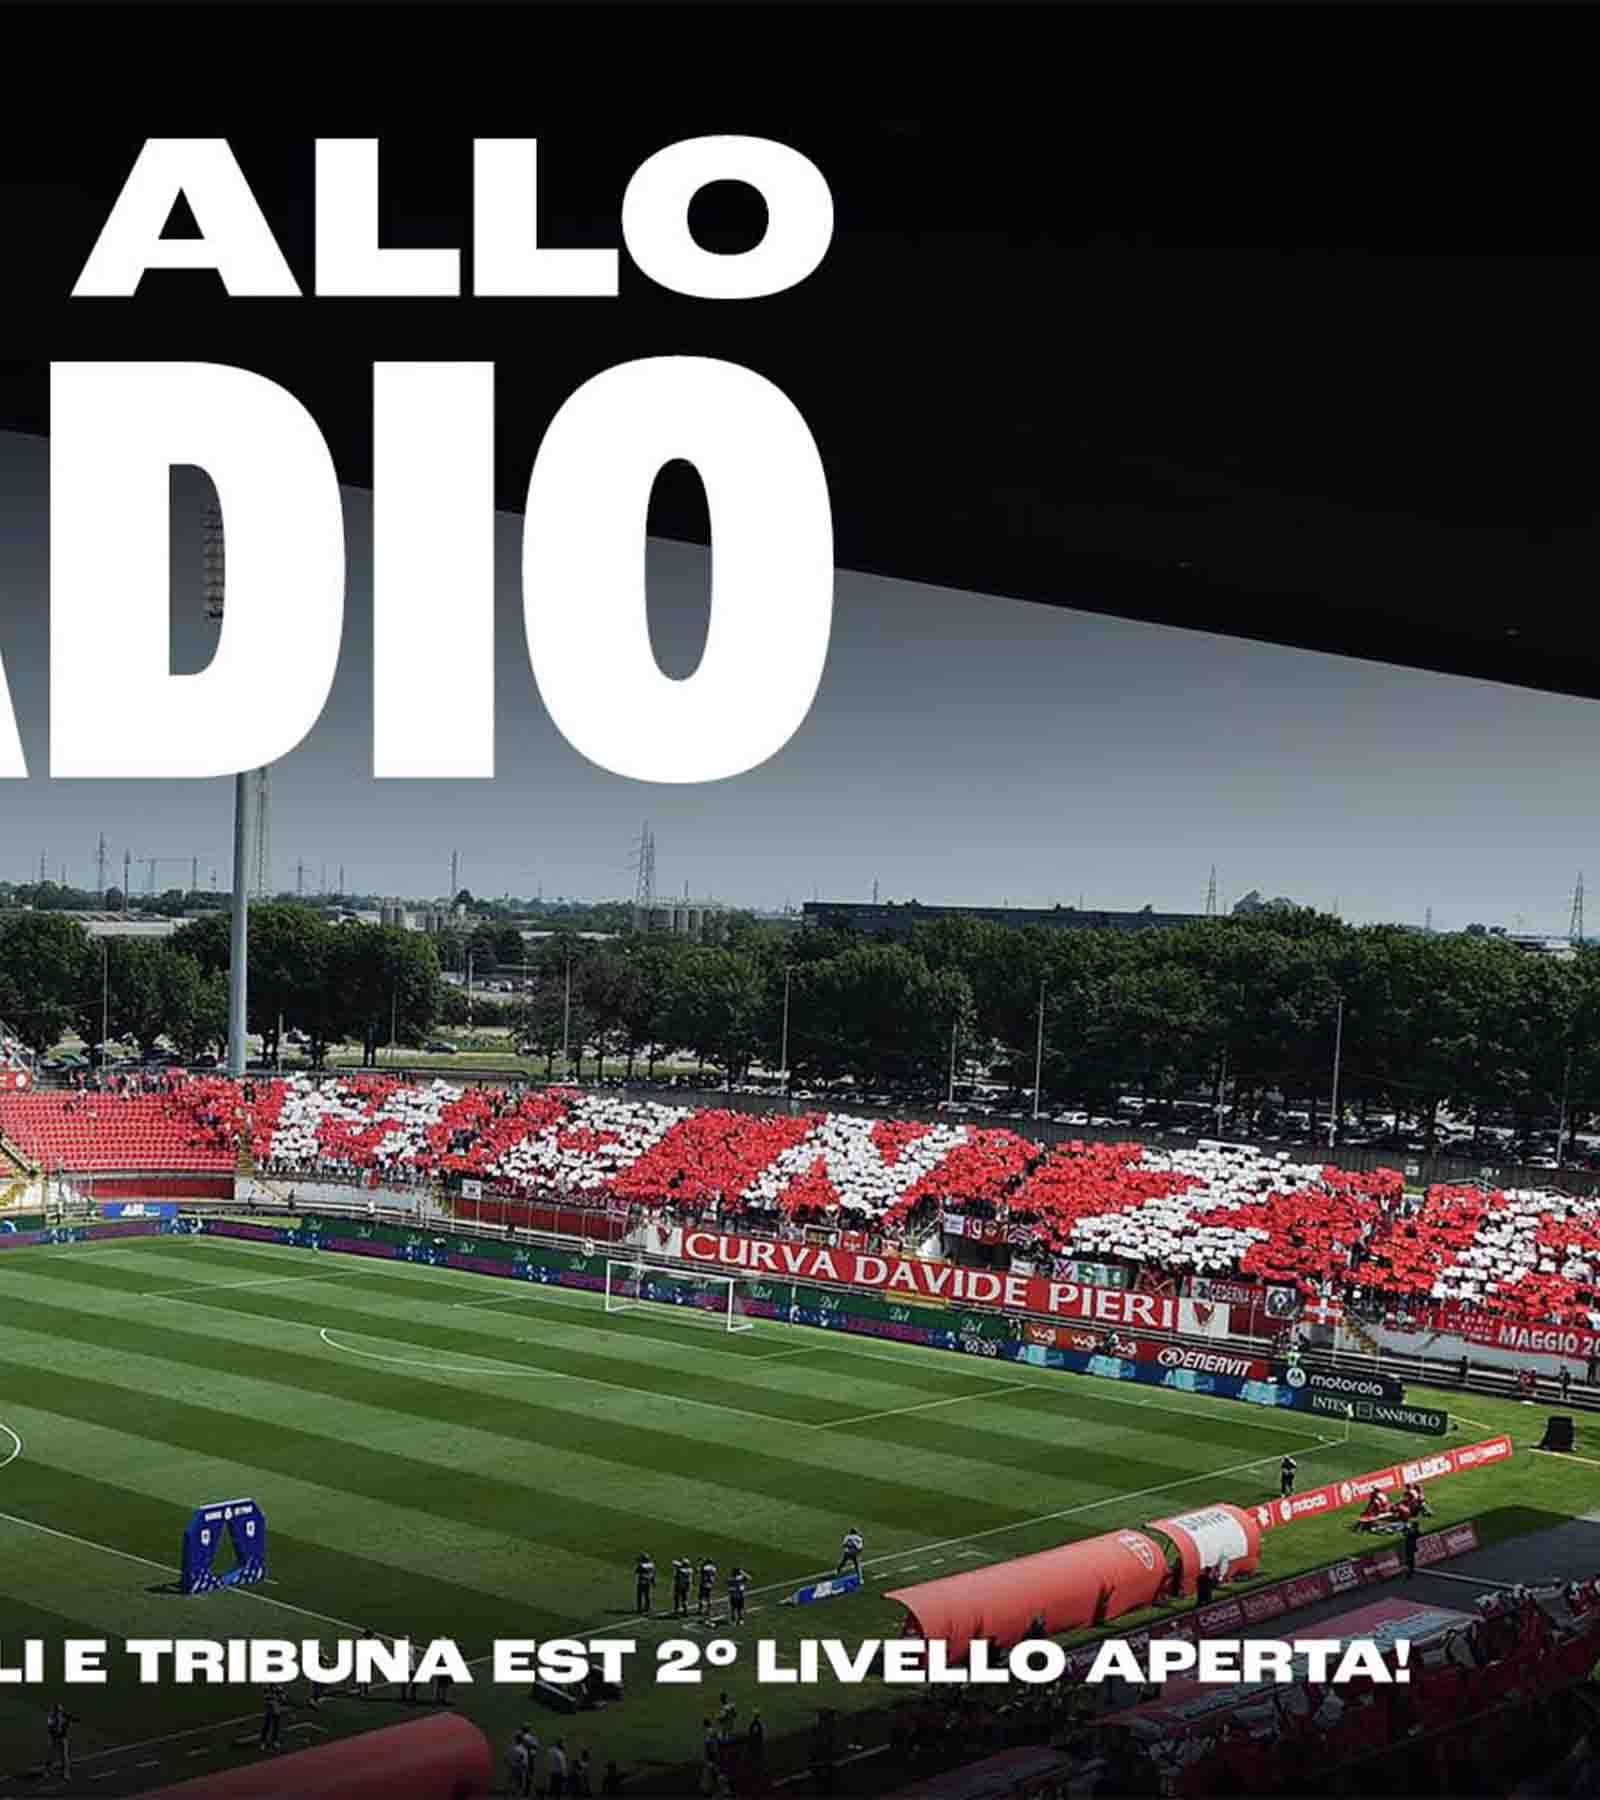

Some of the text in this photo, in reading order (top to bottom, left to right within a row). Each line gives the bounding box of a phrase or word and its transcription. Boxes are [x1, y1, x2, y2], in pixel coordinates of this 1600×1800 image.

[684, 1232, 1174, 1329] CURVA DAVIDE PIERI
[1499, 1324, 1579, 1354] MAGGIO
[1181, 1350, 1252, 1378] ENERVIT
[1309, 1373, 1384, 1397] motorola
